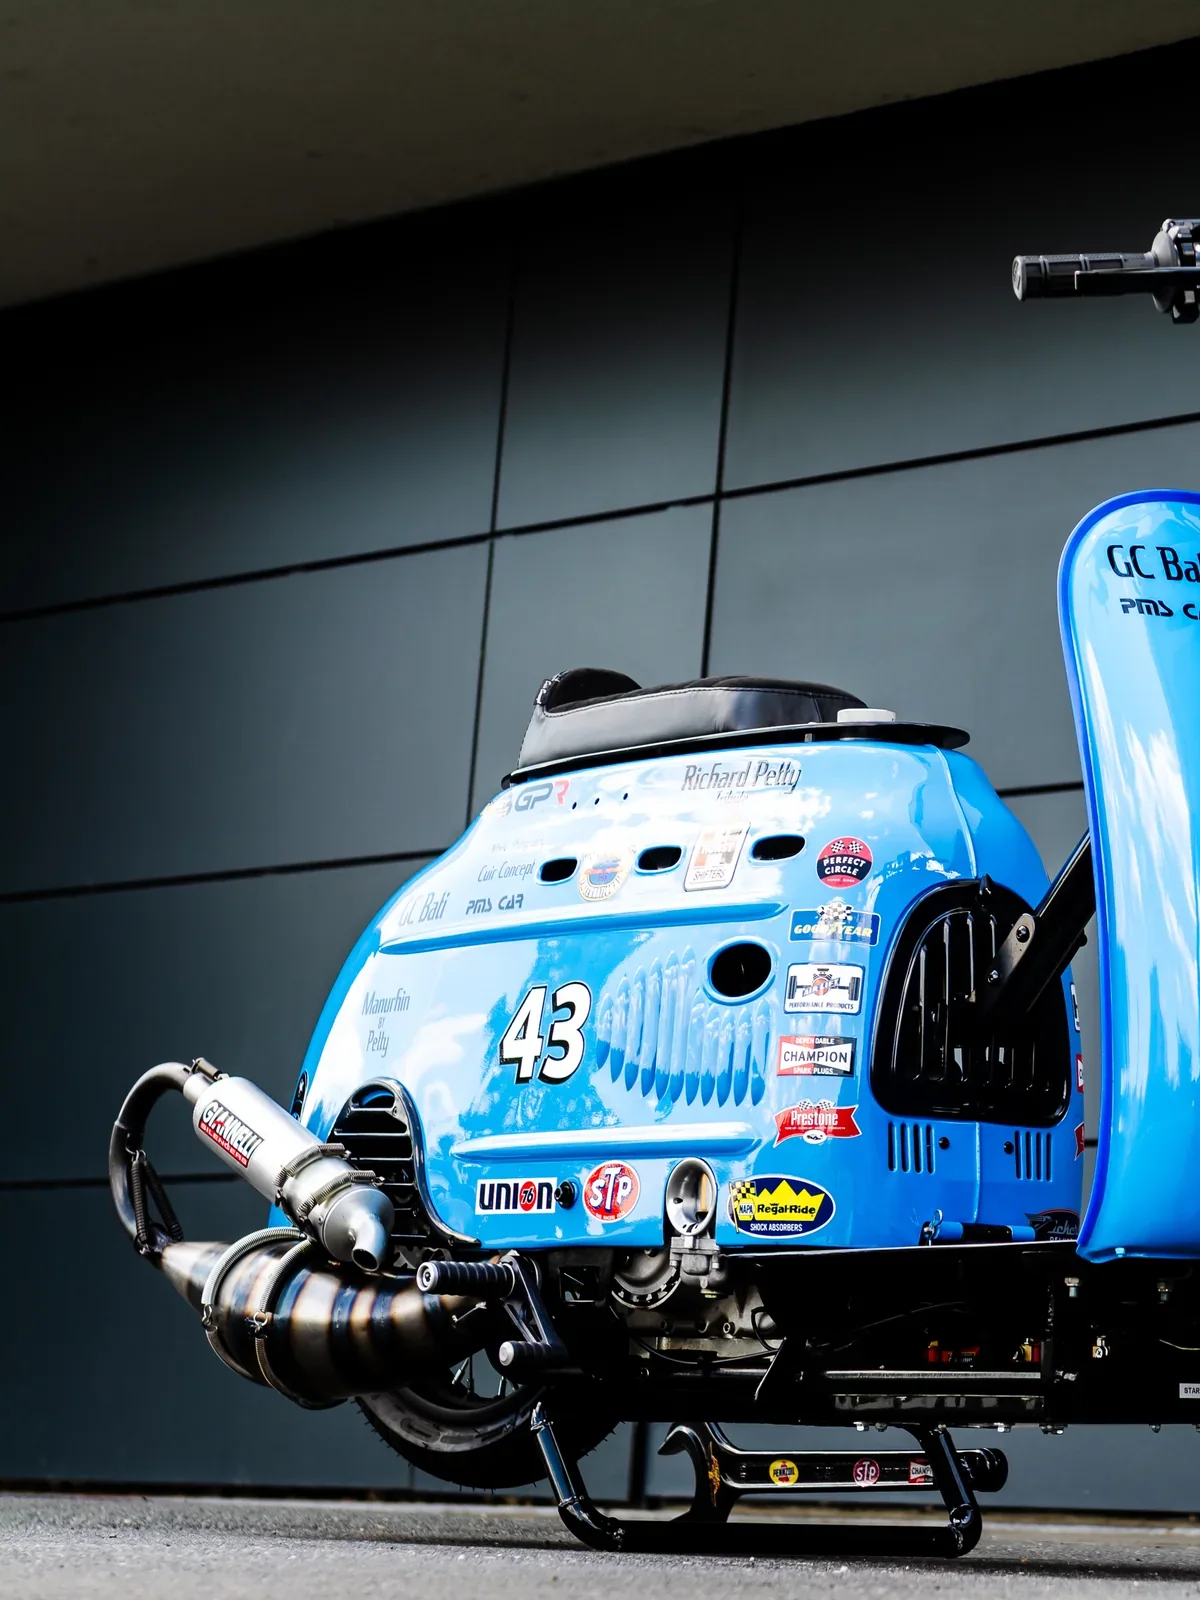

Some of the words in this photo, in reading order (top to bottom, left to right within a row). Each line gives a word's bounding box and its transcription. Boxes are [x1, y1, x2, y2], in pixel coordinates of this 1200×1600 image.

[1107, 544, 1155, 579] GC
[681, 761, 752, 791] Richard
[752, 760, 802, 794] Petty
[514, 780, 570, 812] GPR
[477, 864, 497, 882] Cuir
[498, 859, 536, 881] Concept
[823, 856, 866, 868] PERFECT
[824, 865, 859, 876] CIRCLE
[398, 894, 424, 927] GC
[418, 891, 450, 923] Bati
[497, 893, 524, 911] CAR
[361, 987, 411, 1015] Manurhin
[788, 1001, 824, 1009] PERFORMANCE
[826, 1001, 854, 1010] PRODUCTS
[377, 1017, 386, 1028] BY
[499, 981, 592, 1085] 43
[366, 1030, 389, 1058] Petty
[783, 1050, 848, 1063] CHAMPION
[793, 1067, 812, 1075] SPARK
[813, 1067, 834, 1075] PLUGS
[790, 1109, 838, 1126] Prestone
[203, 1101, 262, 1159] GIANNELLI
[521, 1187, 535, 1205] 76
[589, 1167, 633, 1213] STP
[739, 1204, 753, 1214] NAPA
[750, 1223, 768, 1231] SHOCK
[768, 1223, 803, 1232] ABSORBERS
[856, 1461, 876, 1481] STP
